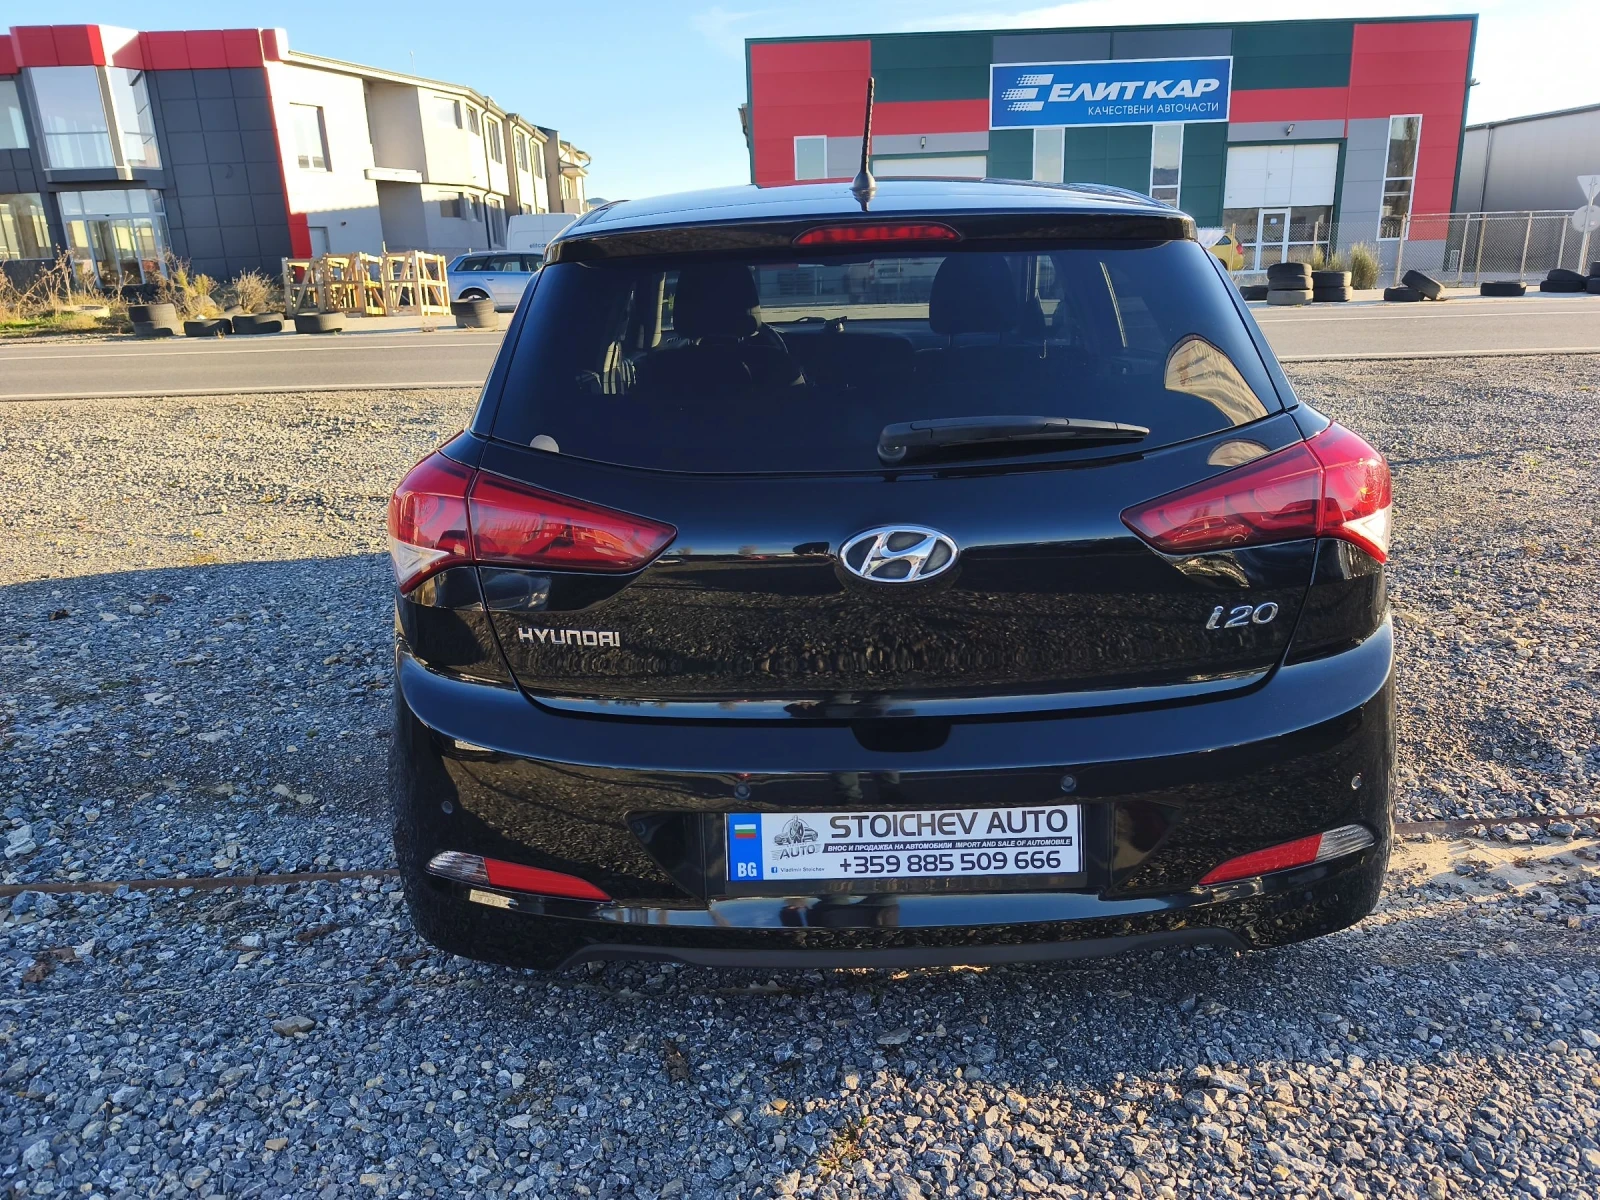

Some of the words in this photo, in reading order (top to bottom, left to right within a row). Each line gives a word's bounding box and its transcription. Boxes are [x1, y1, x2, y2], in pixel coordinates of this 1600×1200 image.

[1088, 105, 1154, 116] КАЧЕСТВЕНИ
[1156, 102, 1219, 114] АВТОЧАСТИ
[1206, 602, 1279, 629] i20
[518, 627, 620, 647] HYUNDAI
[829, 811, 979, 839] STOICHEV
[986, 808, 1069, 834] AUTO
[780, 845, 816, 859] AUTO
[854, 844, 893, 852] ПРОДАЖБА
[905, 842, 953, 850] АВТОМОБИЛИ
[737, 862, 757, 877] BG
[840, 855, 900, 873] +359
[907, 854, 954, 872] 885
[960, 851, 1008, 871] 509
[1014, 850, 1061, 870] 666
